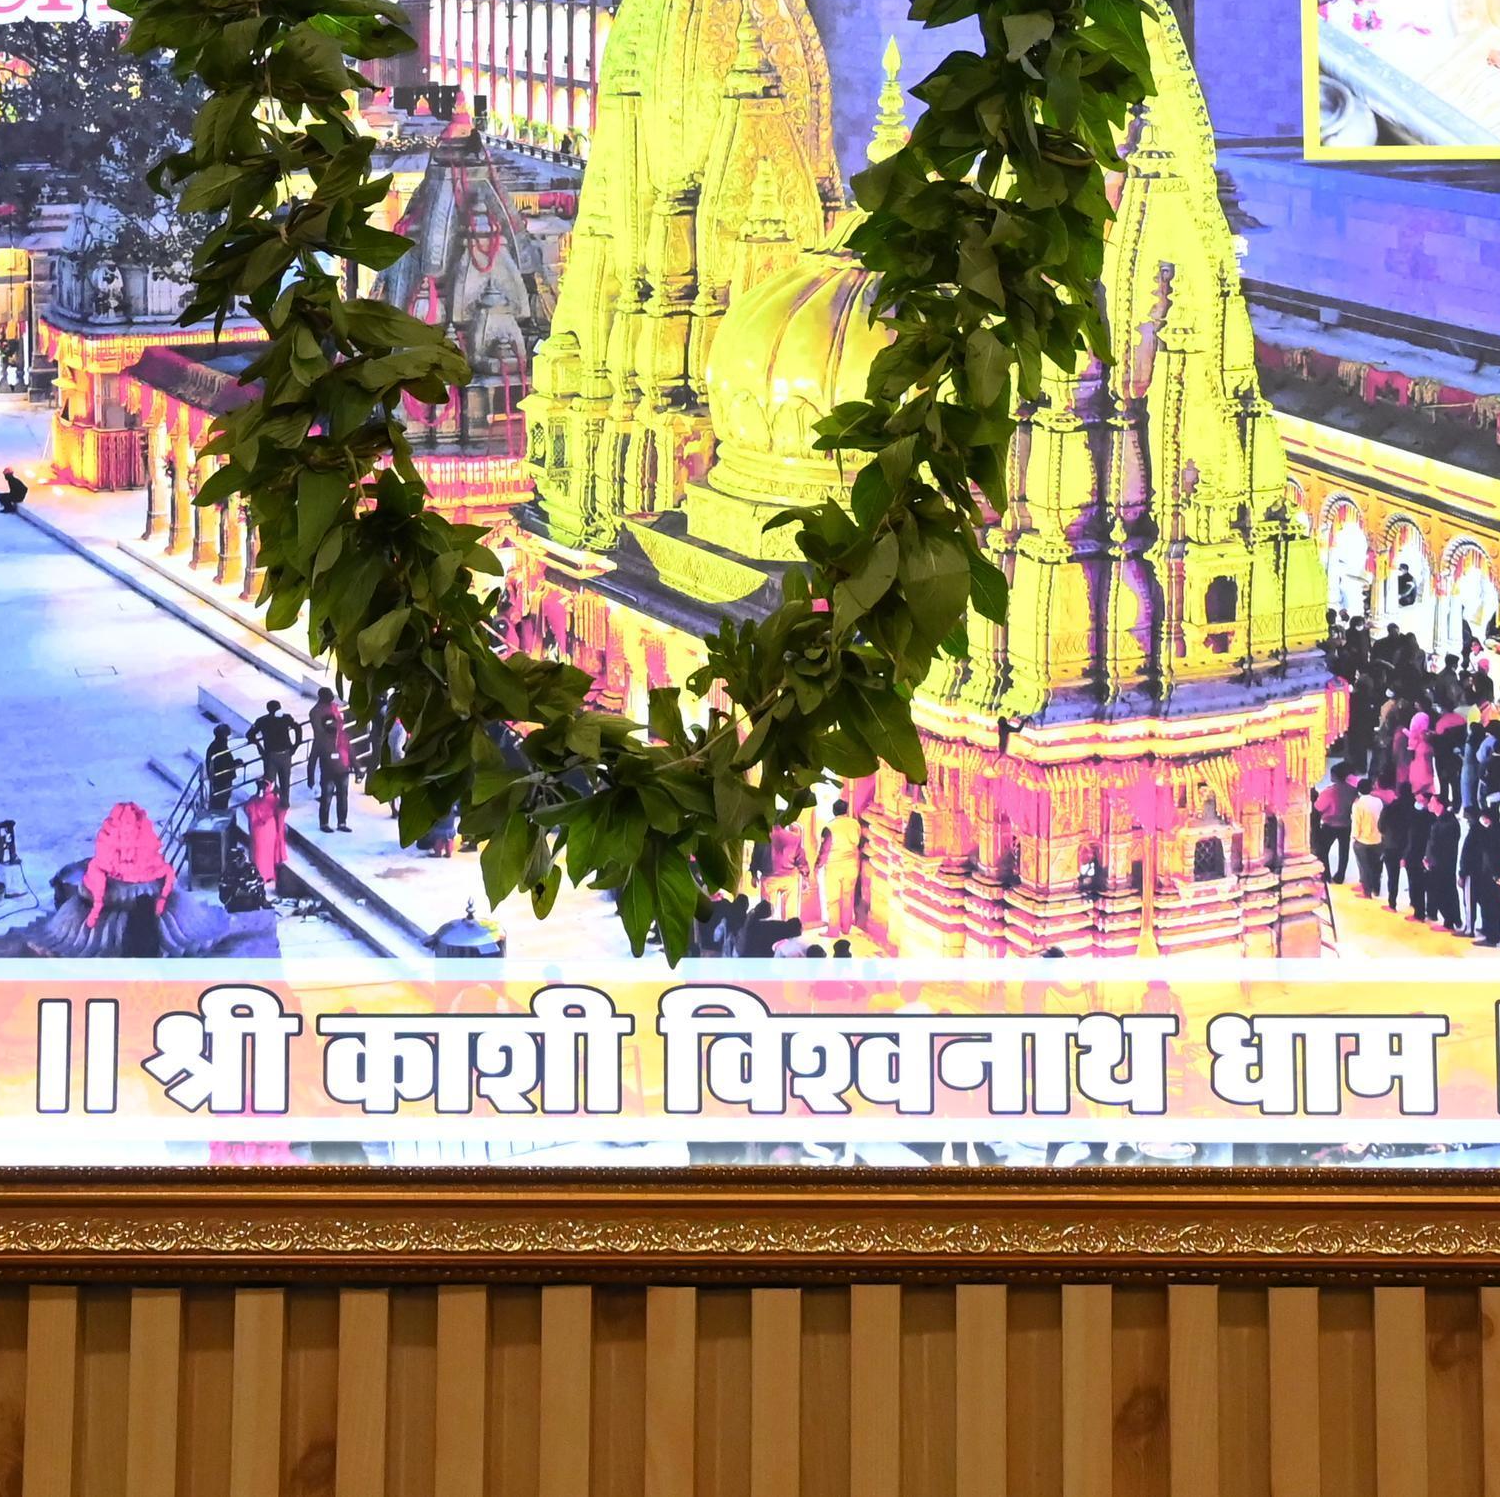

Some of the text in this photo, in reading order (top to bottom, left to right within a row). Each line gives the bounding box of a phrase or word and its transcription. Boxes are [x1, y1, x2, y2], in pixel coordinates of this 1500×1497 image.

[141, 984, 303, 1114] श्री
[316, 984, 636, 1115] काशी
[656, 984, 1180, 1115] विश्वनाथ
[1206, 1012, 1450, 1116] धाम
